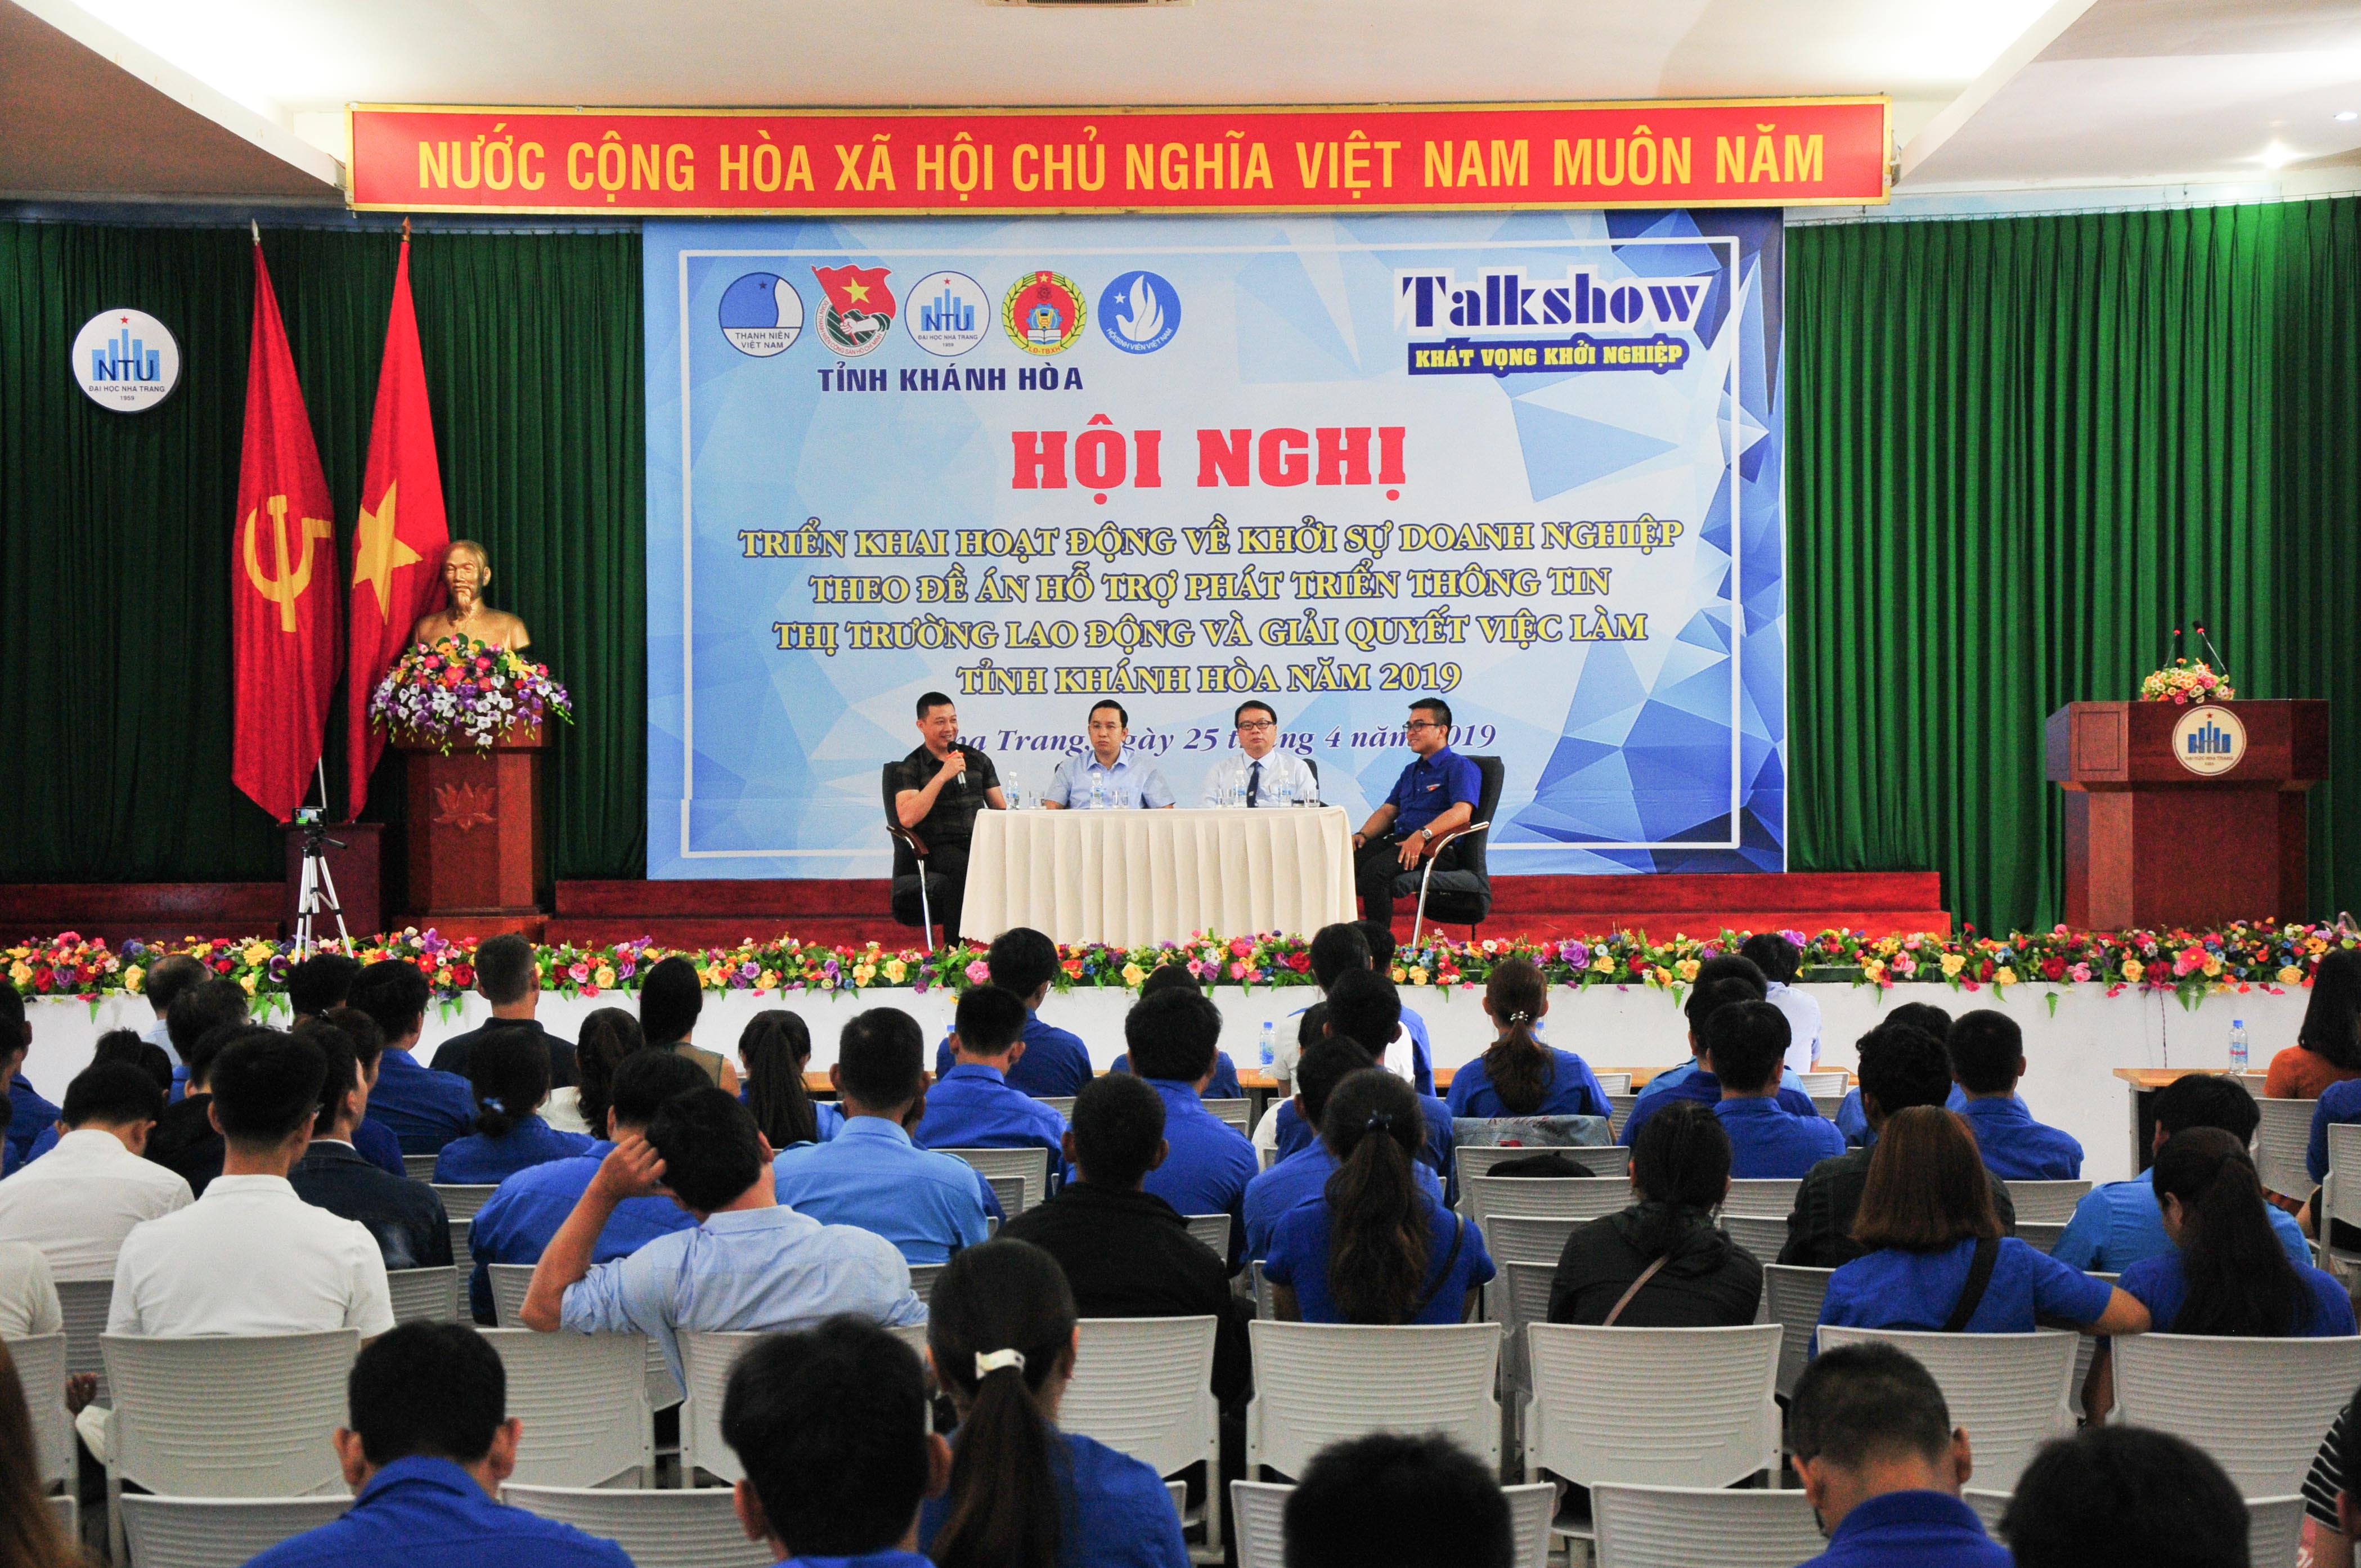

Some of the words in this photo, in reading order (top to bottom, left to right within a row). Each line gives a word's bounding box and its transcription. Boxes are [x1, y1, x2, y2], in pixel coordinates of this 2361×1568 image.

[419, 123, 545, 189] NƯỚC
[567, 130, 695, 203] CỘNG
[720, 129, 815, 191] HÒA
[835, 133, 896, 191] XÃ
[917, 131, 992, 201] HỘI
[1013, 125, 1105, 191] CHỦ
[1127, 132, 1273, 190] NGHĨA
[1296, 131, 1402, 199] VIỆT
[1424, 140, 1529, 188] NAM
[1554, 126, 1691, 186] MUÔN
[1716, 123, 1824, 183] NĂM
[1403, 273, 1700, 327] Talkshow
[769, 330, 790, 339] NIÊN
[926, 313, 969, 331] NTU
[741, 340, 760, 349] VIỆT
[1416, 346, 1474, 367] KHÁT
[1481, 348, 1537, 370] VỌNG
[1544, 340, 1596, 365] KHỞI
[1604, 341, 1682, 367] NGHIỆP
[99, 360, 154, 381] NTU
[817, 361, 887, 391] TỈNH
[900, 363, 1006, 390] KHÁNH
[1018, 362, 1083, 390] HÒA
[1012, 414, 1161, 505] HỘI
[1197, 426, 1406, 501] NGHỊ
[739, 518, 846, 558] TRIỂN
[855, 530, 951, 558] KHAI
[956, 530, 1060, 562] HOẠT
[1066, 522, 1176, 561] ĐỘNG
[1183, 514, 1231, 555] VỀ
[1238, 516, 1337, 553] KHỞI
[1344, 521, 1394, 559] SỰ
[1399, 522, 1538, 551] DOANH
[1542, 513, 1684, 555] NGHIỆP
[809, 574, 910, 603] THEO
[916, 563, 968, 603] ĐỀ
[976, 566, 1027, 603] ÁN
[1036, 561, 1093, 602] HỖ
[1102, 573, 1177, 606] TRỢ
[1185, 565, 1283, 599] PHÁT
[1290, 559, 1403, 599] TRIỂN
[1408, 563, 1541, 597] THÔNG
[1547, 567, 1611, 595] TIN
[773, 621, 838, 656] THỊ
[846, 613, 999, 649] TRƯỜNG
[1006, 622, 1078, 648] LAO
[1085, 614, 1195, 653] ĐỘNG
[1201, 610, 1252, 645] VÀ
[1259, 609, 1338, 645] GIẢI
[1346, 605, 1470, 650] QUYẾT
[1476, 609, 1562, 649] VIỆC
[1569, 606, 1648, 642] LÀM
[957, 658, 1047, 695] TỈNH
[1055, 659, 1190, 694] KHÁNH
[1197, 657, 1281, 693] HÒA
[1287, 658, 1372, 691] NĂM
[1380, 663, 1461, 691] 2019
[997, 729, 1089, 757] Trang,
[1122, 727, 1174, 757] gày
[1183, 728, 1219, 751] 25
[1228, 732, 1314, 755] tng
[1325, 726, 1340, 747] 4
[1448, 724, 1496, 748] 019
